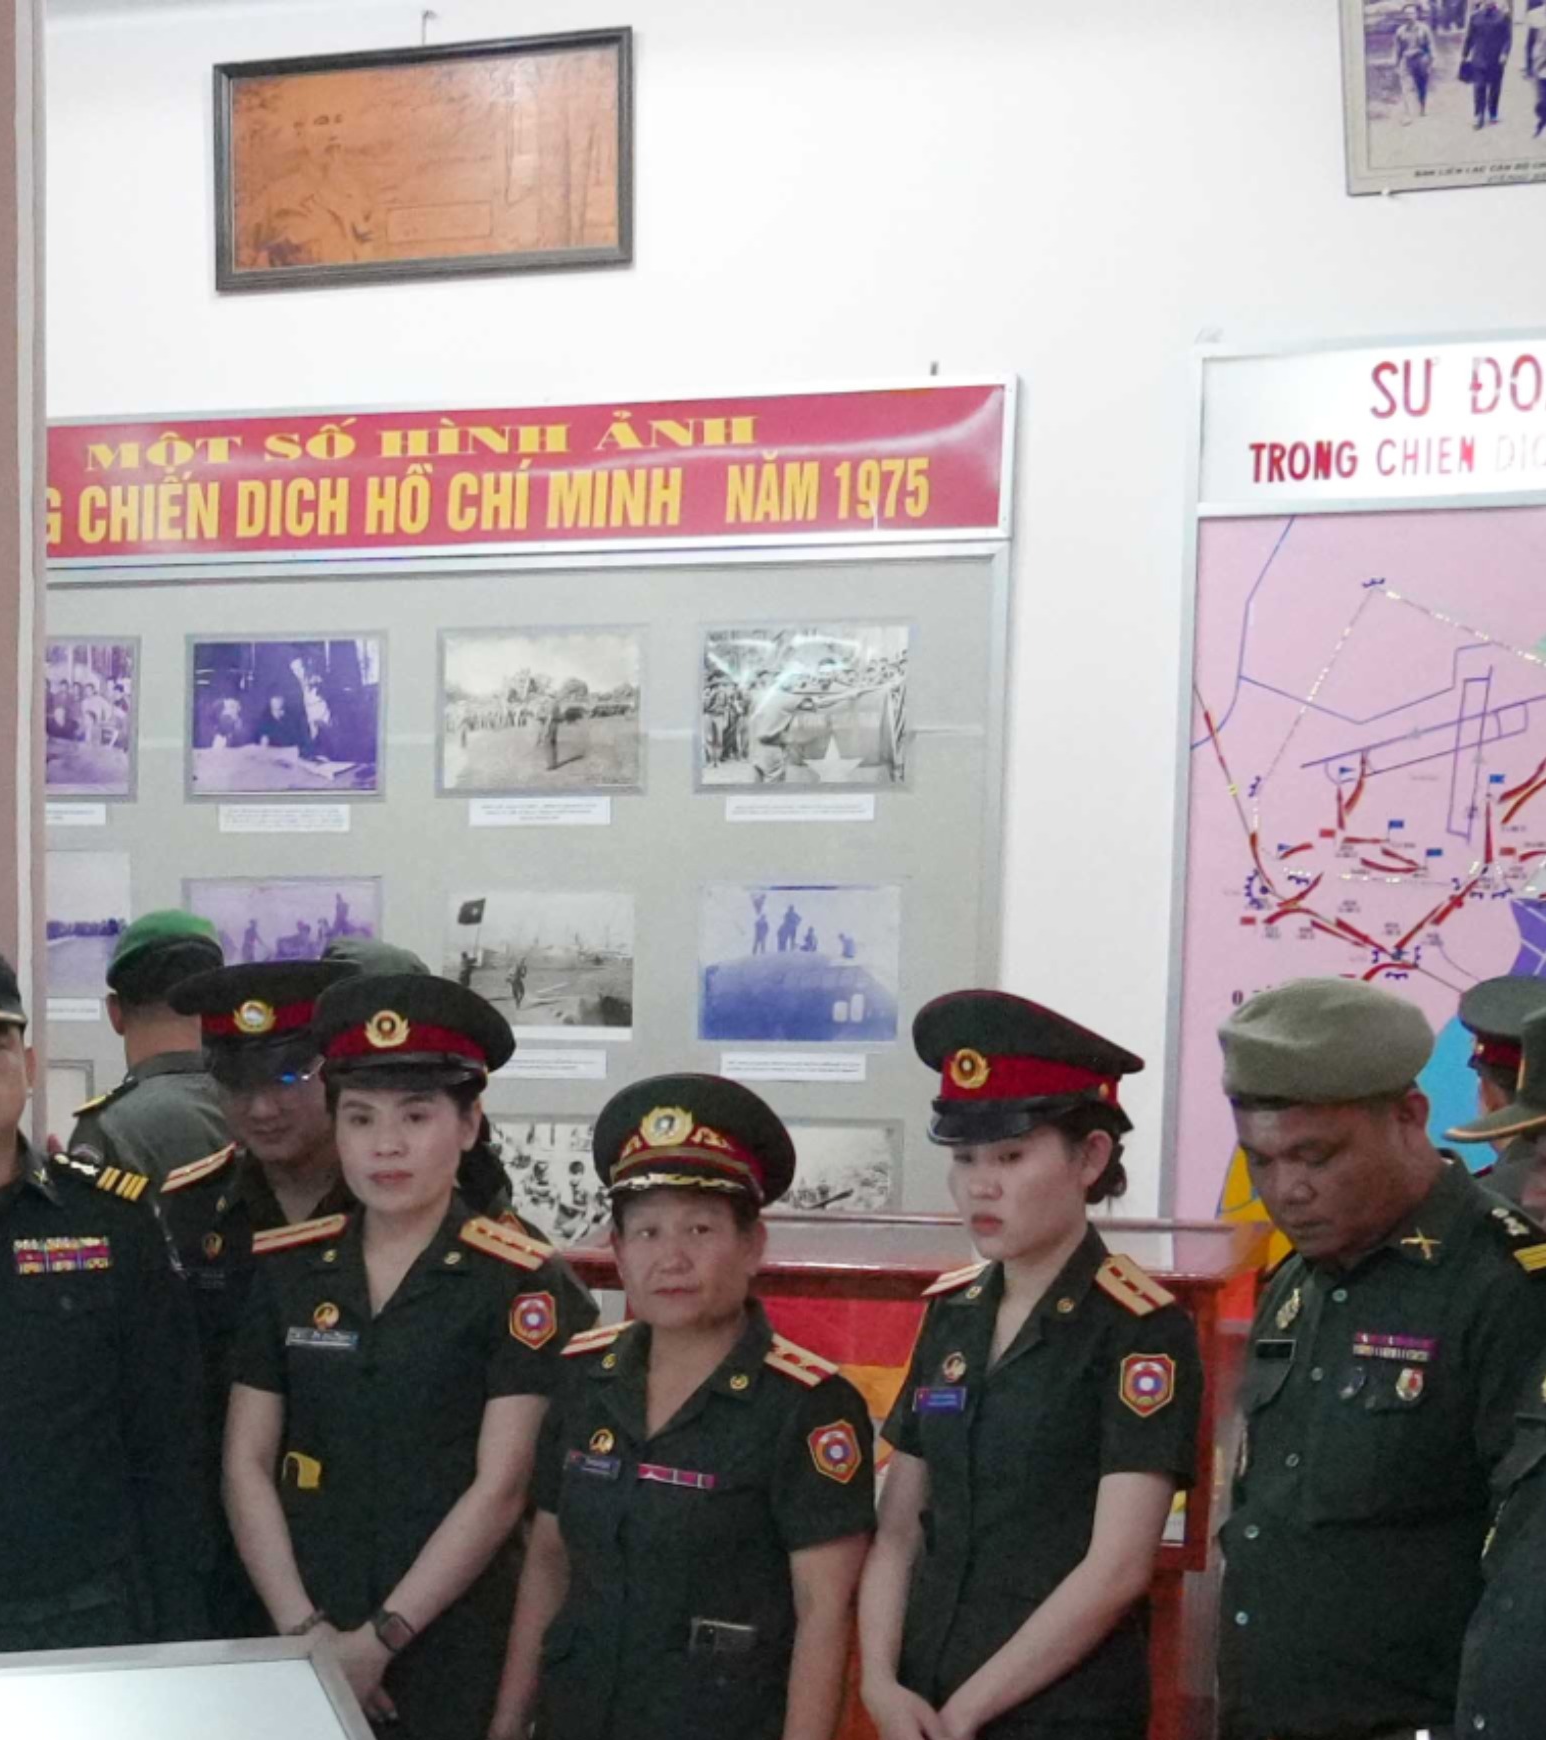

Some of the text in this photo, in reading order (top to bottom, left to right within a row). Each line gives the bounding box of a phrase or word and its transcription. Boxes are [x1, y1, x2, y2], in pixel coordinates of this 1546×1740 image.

[85, 409, 760, 472] MỘT SỐ HÌNH ẢNH
[1247, 438, 1360, 486] TRONG
[77, 468, 220, 545] CHIẾN
[364, 462, 434, 537] HỒ
[446, 459, 533, 534] CHÍ
[546, 466, 684, 532] MINH
[726, 449, 821, 525] NĂM
[835, 456, 931, 523] 1975
